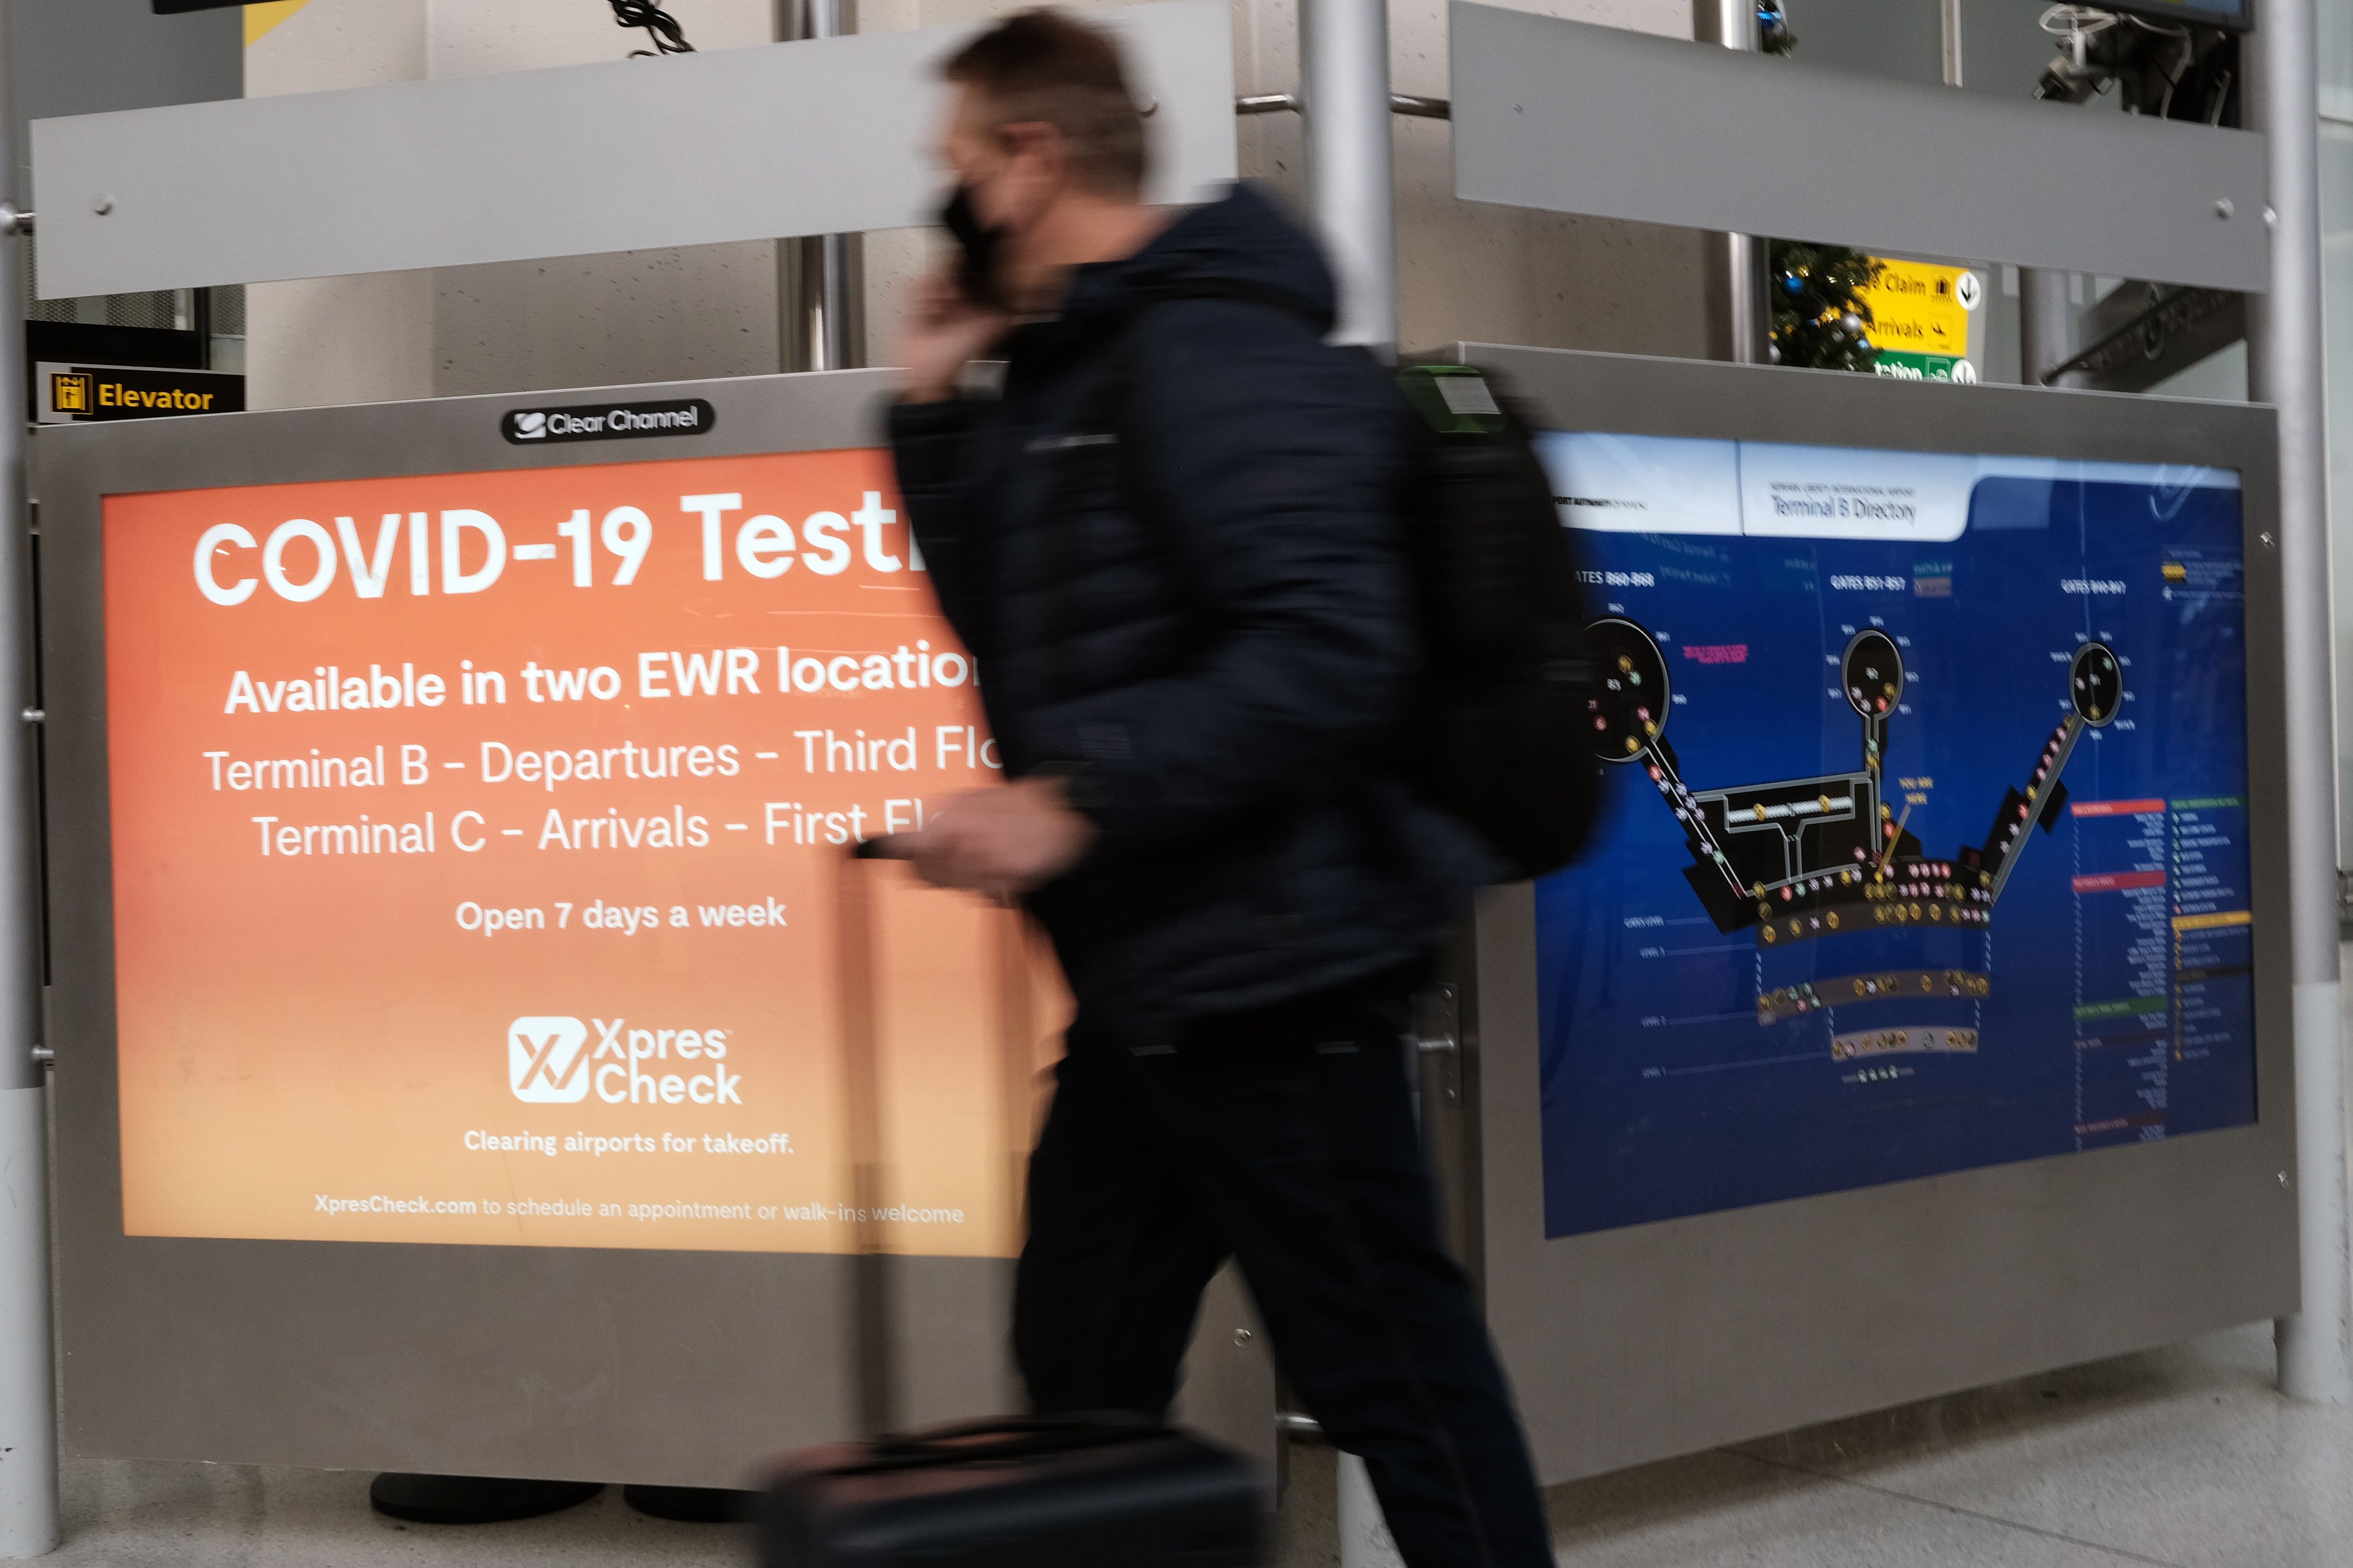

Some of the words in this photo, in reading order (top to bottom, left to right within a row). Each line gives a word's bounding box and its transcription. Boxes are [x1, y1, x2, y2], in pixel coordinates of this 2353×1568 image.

[1884, 273, 1926, 297] Claim
[99, 384, 214, 410] Elevator
[548, 413, 606, 435] Clear
[607, 405, 699, 431] Channel
[1771, 494, 1836, 519] Terminal
[1838, 497, 1850, 518] B
[1852, 496, 1916, 527] Directory
[193, 505, 653, 607] COVID-19
[680, 490, 926, 582] Test
[1575, 571, 1604, 584] ATES
[223, 662, 447, 715] Available
[460, 660, 507, 706] in
[520, 661, 622, 704] two
[638, 648, 762, 699] EWR
[778, 639, 978, 694] locatio
[203, 745, 386, 792] Terminal
[401, 744, 430, 786] B
[481, 740, 741, 793] Departures
[794, 726, 918, 774] Third
[936, 725, 1004, 770] Flo
[252, 811, 436, 857] Terminal
[450, 810, 487, 853] C
[538, 805, 710, 851] Arrivals
[764, 801, 869, 846] First
[455, 901, 546, 938] Open
[554, 902, 574, 929] 7
[582, 899, 660, 937] days
[669, 906, 690, 929] a
[698, 896, 788, 928] week
[591, 1018, 727, 1064] Xpres
[595, 1062, 743, 1105] Check
[464, 1130, 558, 1157] Clearing
[564, 1130, 657, 1158] airports
[663, 1132, 695, 1154] for
[702, 1132, 794, 1155] takeoff.
[315, 1194, 477, 1216] XpresCheck.com
[482, 1199, 502, 1216] to
[507, 1198, 594, 1218] schedule
[598, 1203, 623, 1218] an
[627, 1200, 752, 1223] appointment
[757, 1206, 779, 1220] or
[783, 1201, 867, 1222] walk-ins
[872, 1203, 965, 1224] welcome
